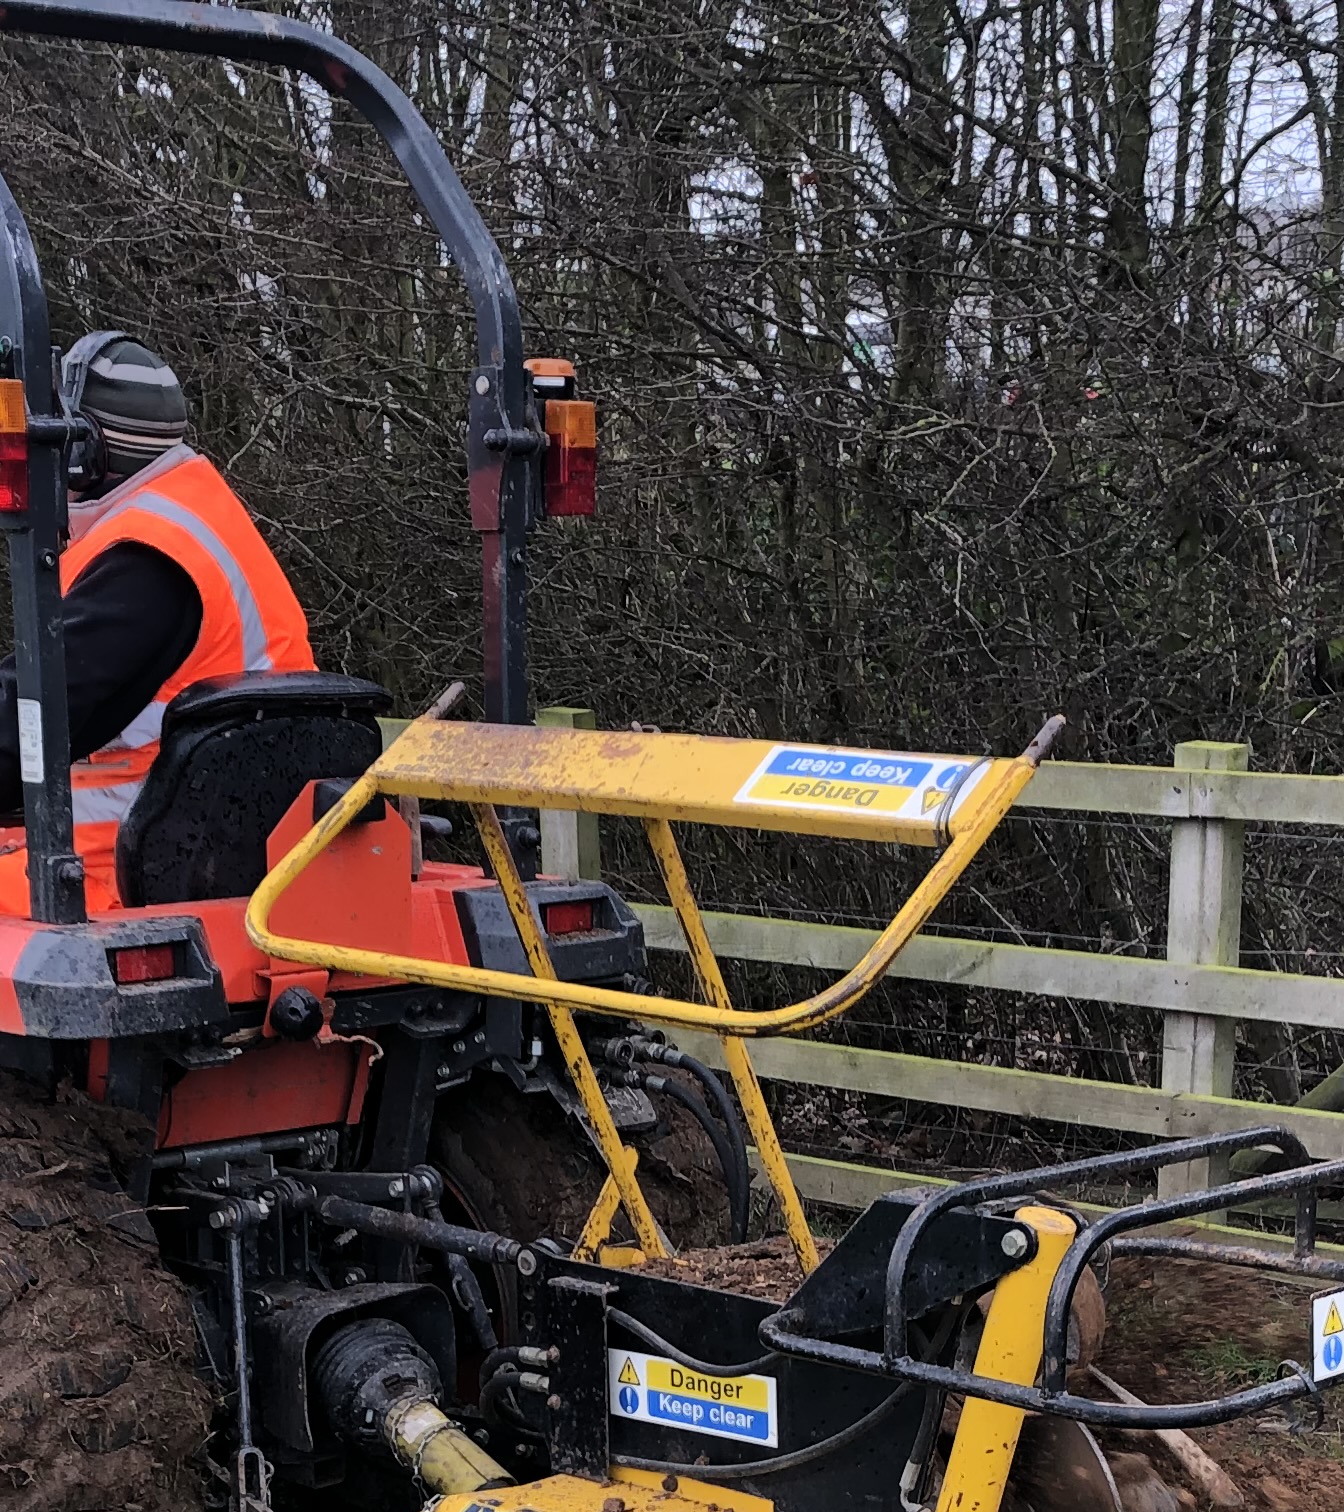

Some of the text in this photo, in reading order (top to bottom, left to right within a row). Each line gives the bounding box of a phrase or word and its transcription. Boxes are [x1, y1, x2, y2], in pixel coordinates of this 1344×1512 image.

[786, 758, 912, 784] Keep clear
[780, 780, 879, 806] Danger
[670, 1368, 743, 1400] Danger
[659, 1393, 755, 1429] Keep clear
